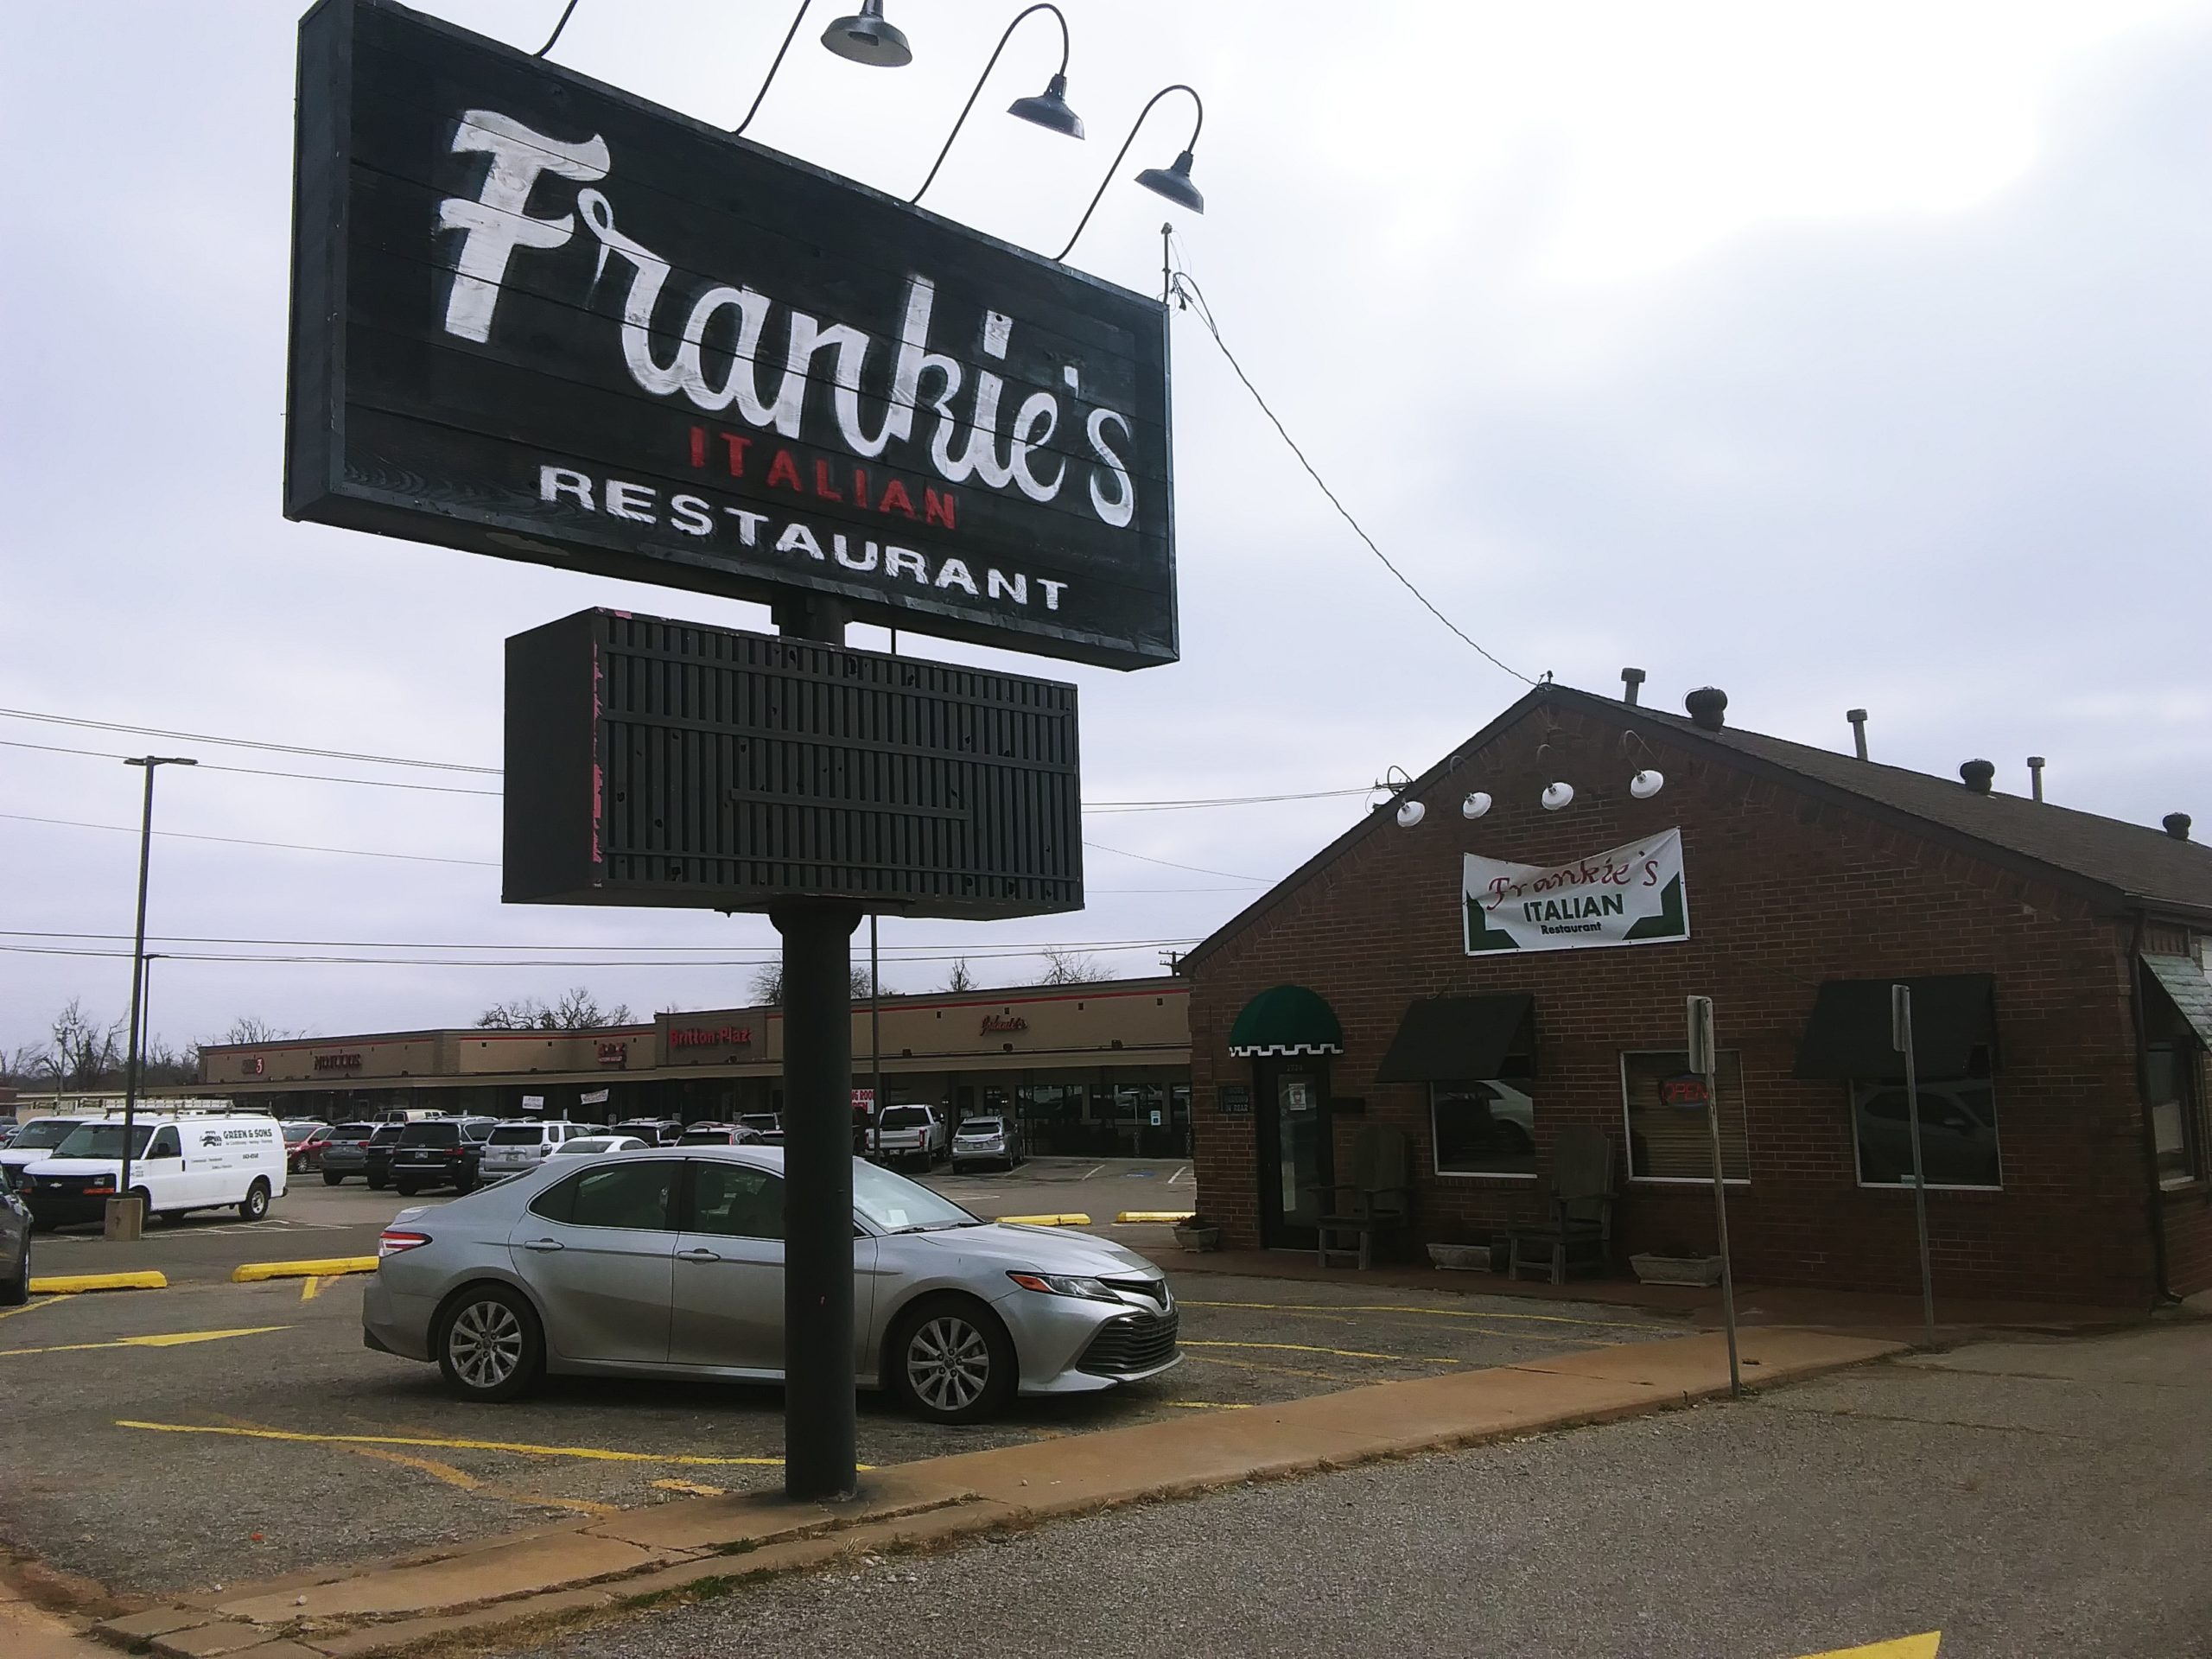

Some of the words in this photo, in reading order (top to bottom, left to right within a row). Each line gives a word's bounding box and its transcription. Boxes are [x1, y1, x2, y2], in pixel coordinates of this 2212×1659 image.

[439, 109, 1136, 528] Frankie's
[690, 427, 958, 530] ITALIAN
[537, 464, 1069, 611] RESTAURANT
[1486, 850, 1659, 911] Frankie's
[1523, 893, 1624, 923] ITALIAN
[1541, 922, 1602, 936] Restaurant
[669, 1029, 715, 1048] Britton
[1664, 1082, 1709, 1102] OPEN
[223, 1129, 248, 1140] GREEN
[254, 1128, 273, 1138] SONS
